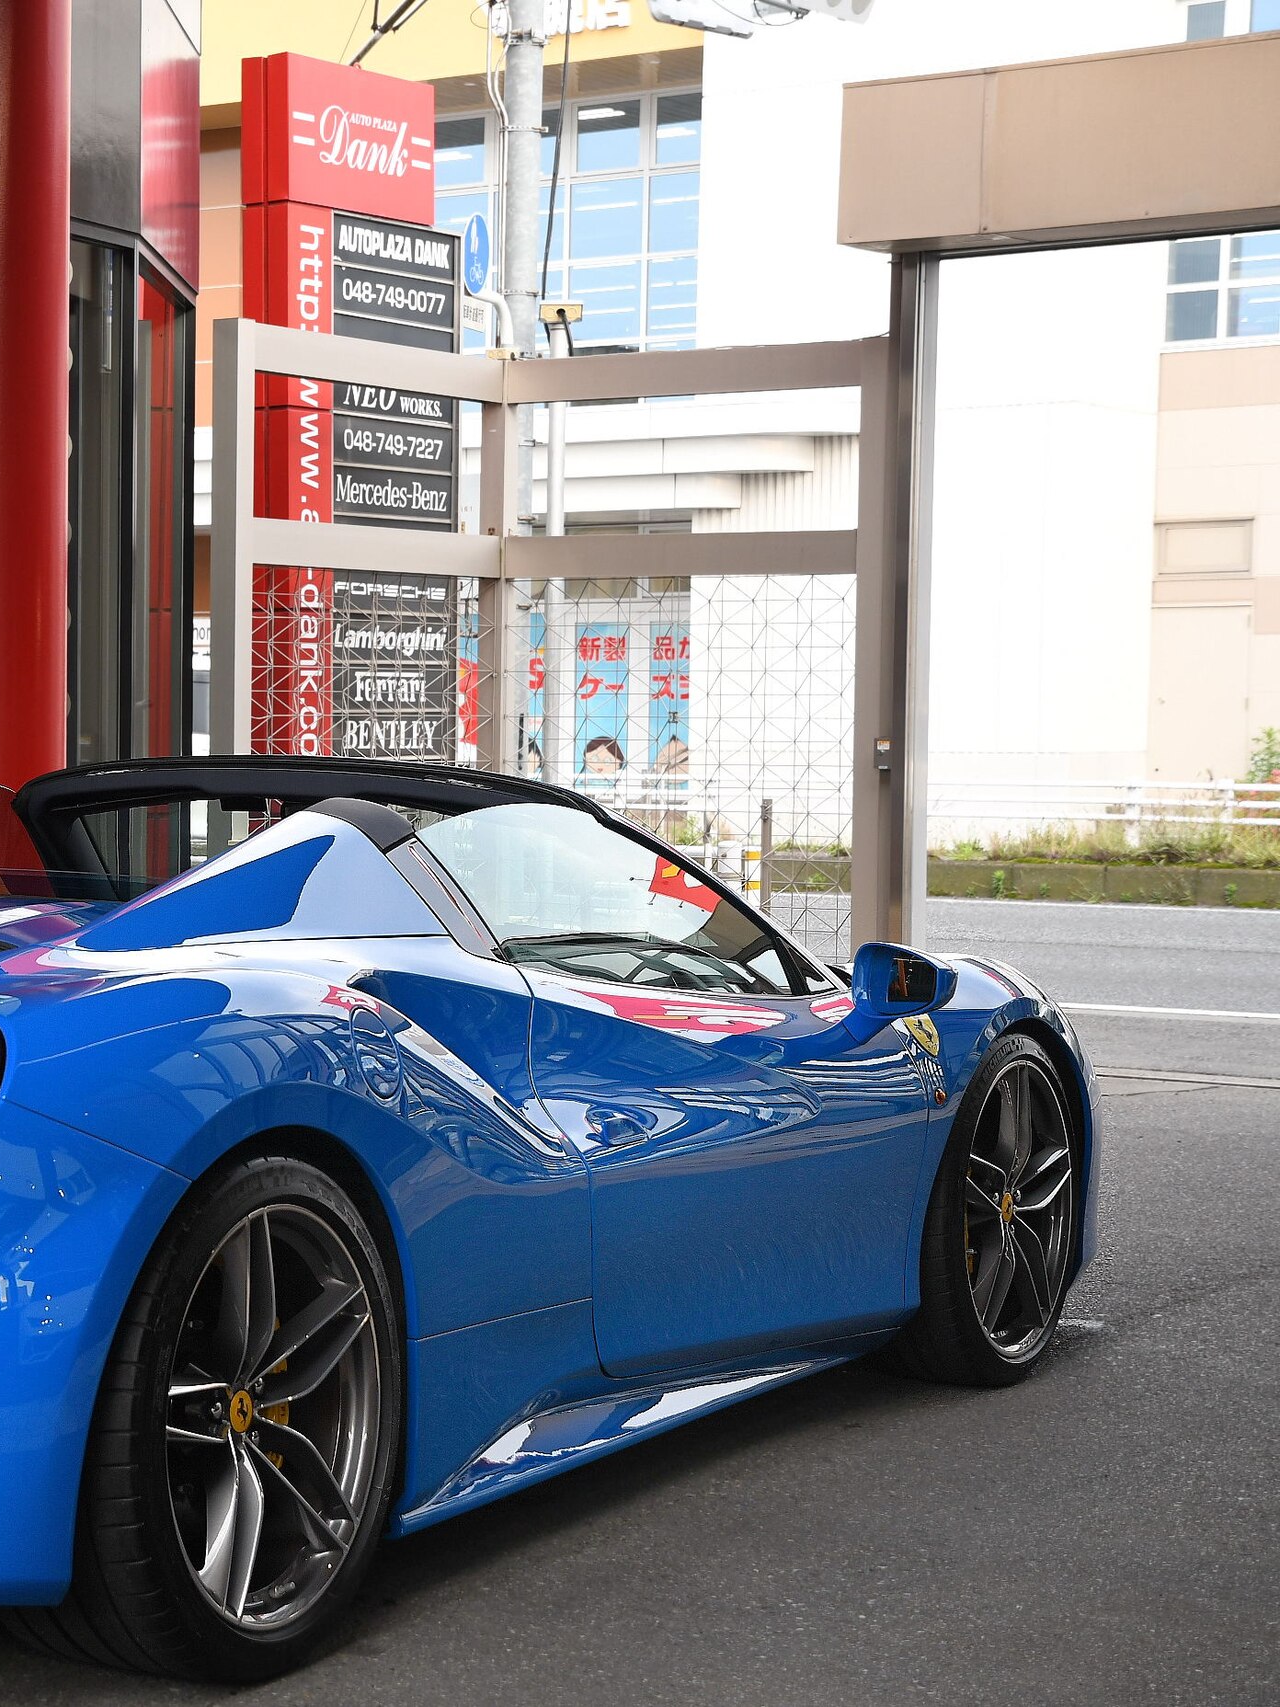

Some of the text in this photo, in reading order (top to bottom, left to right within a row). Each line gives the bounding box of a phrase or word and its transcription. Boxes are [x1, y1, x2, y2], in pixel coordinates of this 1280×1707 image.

[349, 113, 397, 132] AUTO PLAZA
[320, 105, 408, 177] Dank
[338, 224, 450, 269] AUTOPLAZA DANK
[342, 278, 446, 315] 048-749-0077
[343, 428, 444, 461] 048-749-7227
[336, 474, 448, 512] Mercedes-Benz
[334, 581, 447, 600] PORSCHE
[334, 623, 447, 657] Lamborghini
[354, 671, 427, 703] Ferrari
[343, 720, 438, 750] BENTLEY
